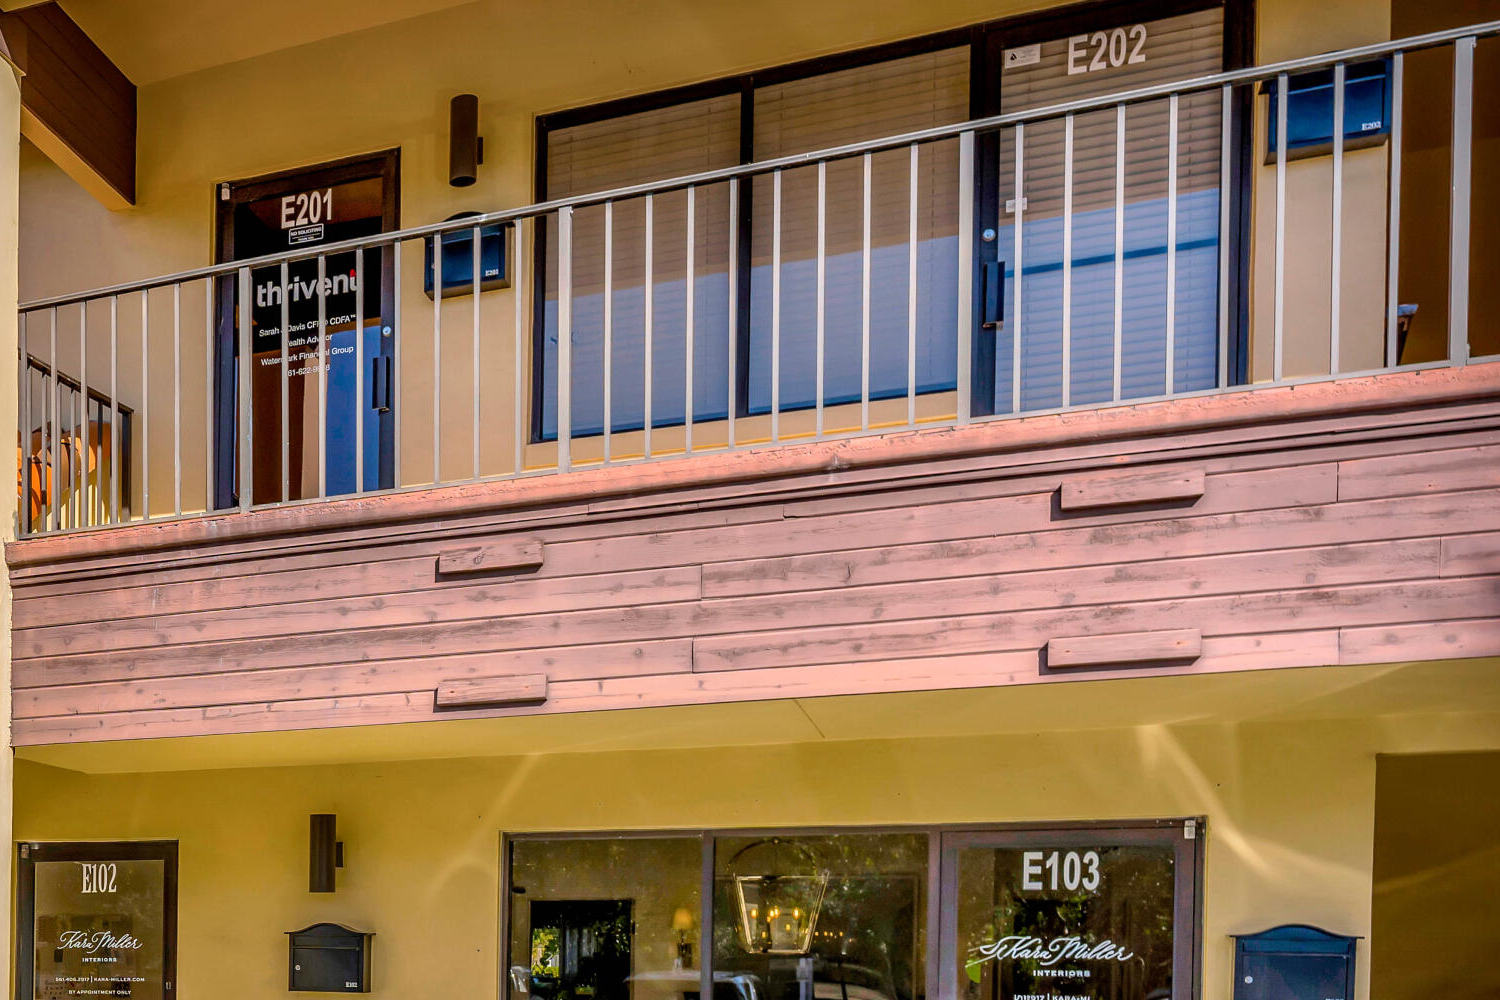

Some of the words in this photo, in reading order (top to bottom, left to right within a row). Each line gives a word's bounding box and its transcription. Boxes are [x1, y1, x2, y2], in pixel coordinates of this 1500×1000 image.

[1067, 23, 1147, 75] E202
[281, 188, 333, 229] E201
[259, 327, 280, 337] Sarah
[288, 337, 306, 347] ealth
[331, 346, 354, 355] Group
[81, 863, 117, 894] E102
[1022, 851, 1100, 891] E103
[57, 930, 94, 950] Kara
[87, 930, 143, 954] Miller
[1040, 935, 1134, 966] Miller
[1032, 969, 1091, 979] INTERIORS
